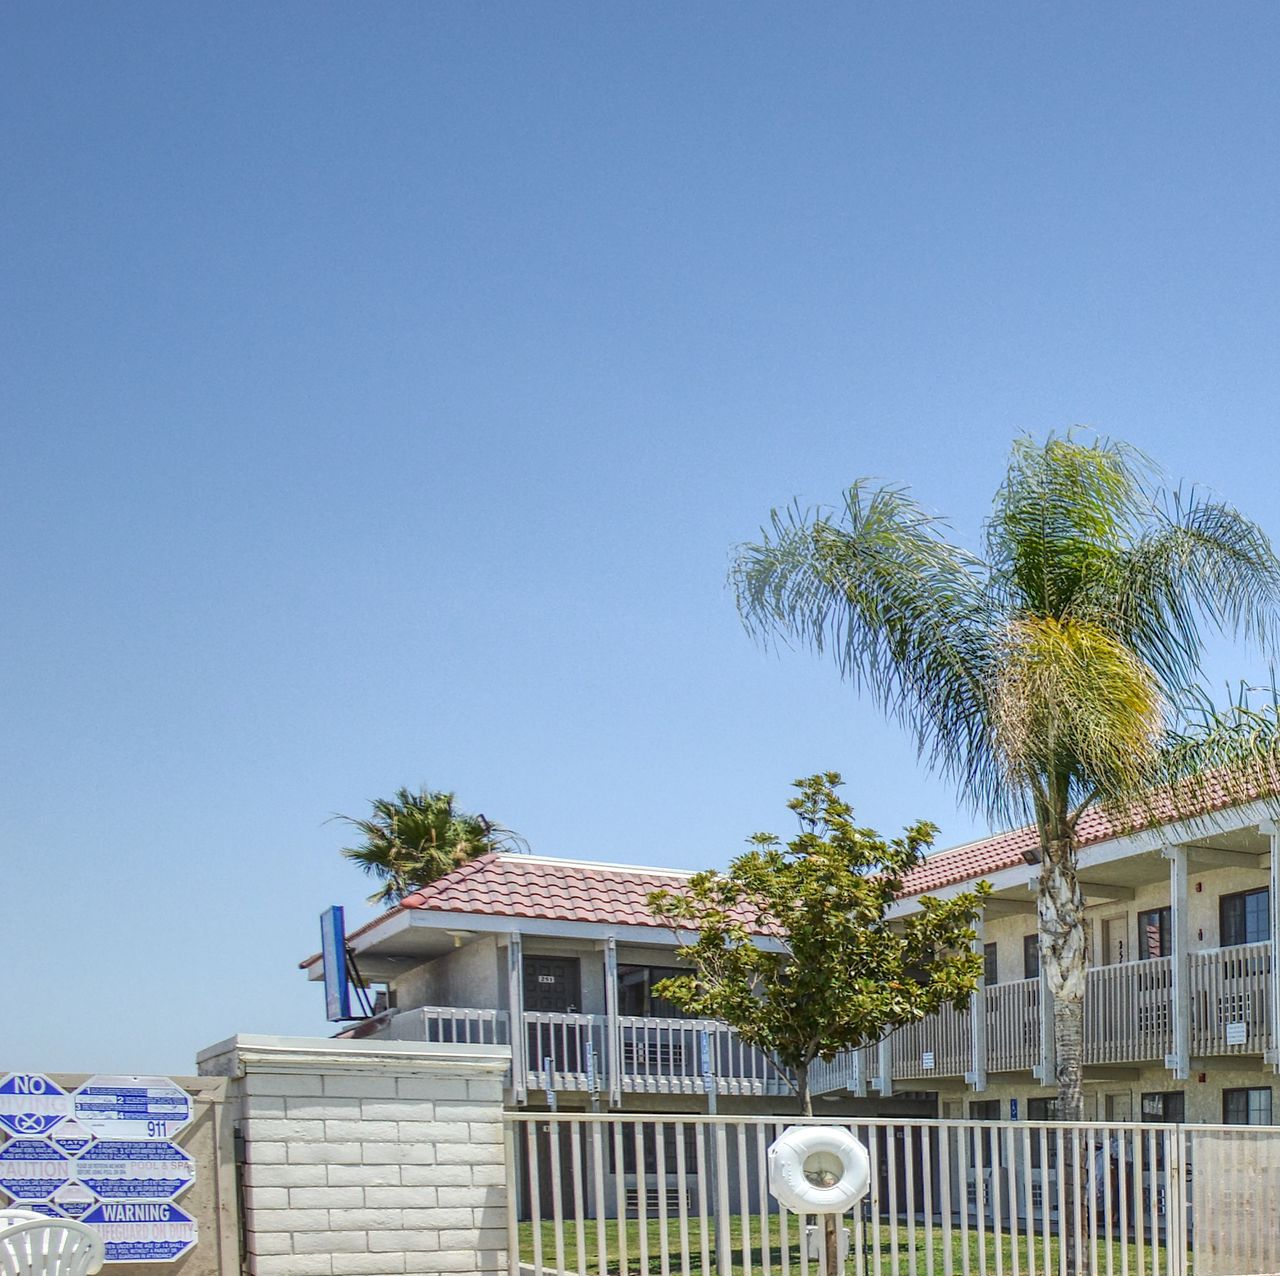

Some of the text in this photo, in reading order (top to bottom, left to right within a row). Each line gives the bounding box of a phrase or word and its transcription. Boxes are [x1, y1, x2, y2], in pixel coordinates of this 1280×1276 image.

[14, 1076, 46, 1095] NO
[147, 1121, 167, 1137] 911
[130, 1161, 159, 1170] POOL
[102, 1204, 170, 1221] WARNING
